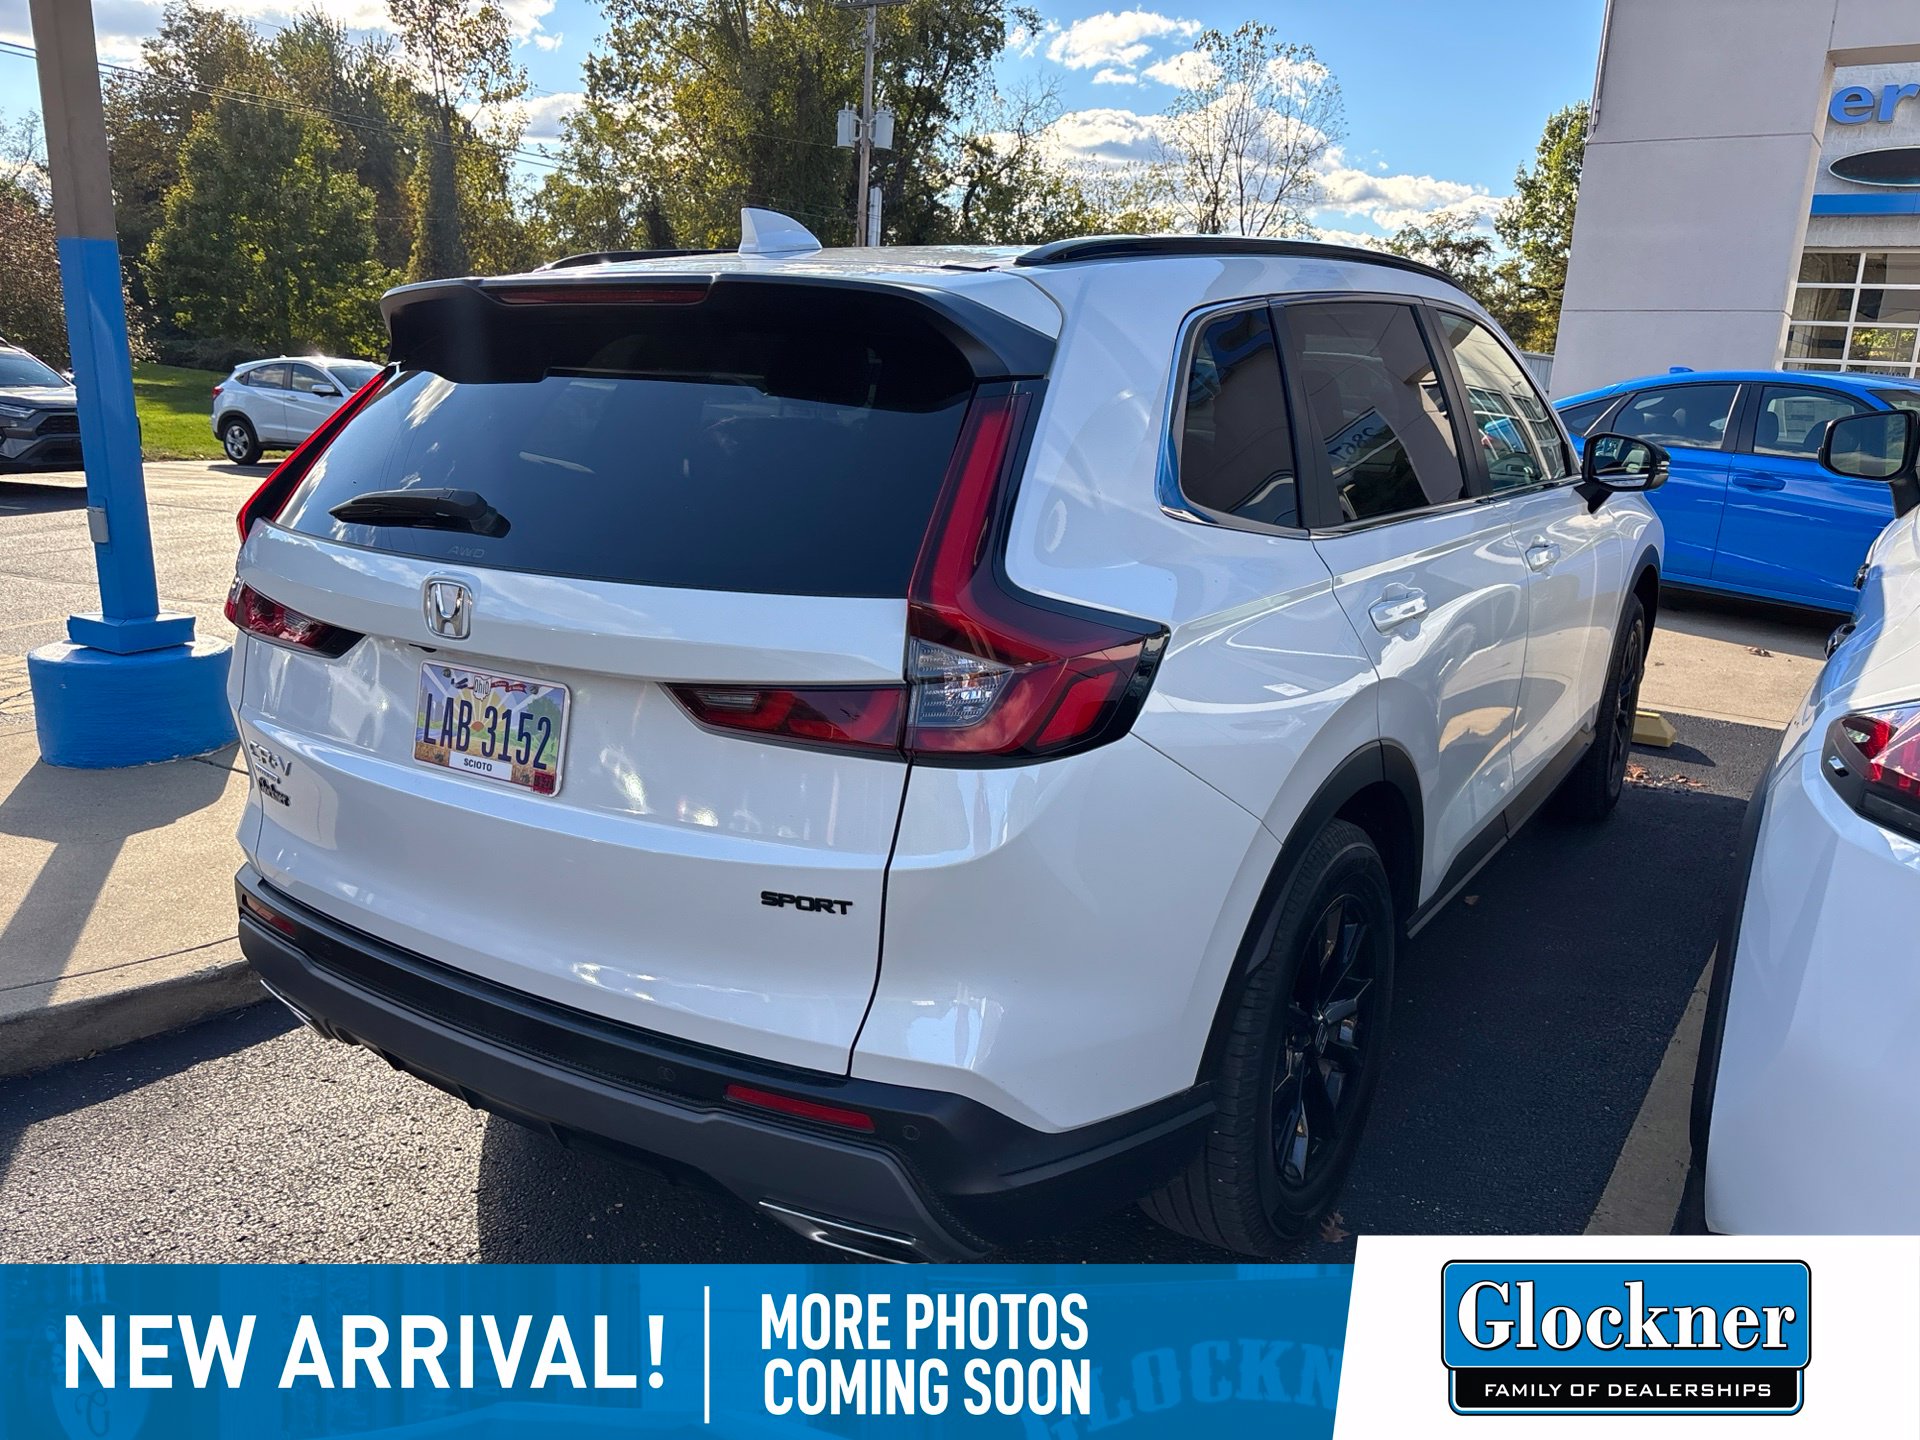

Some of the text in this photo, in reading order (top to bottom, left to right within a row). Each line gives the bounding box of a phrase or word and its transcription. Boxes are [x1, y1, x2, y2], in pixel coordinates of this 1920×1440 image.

[448, 545, 485, 558] AWD
[423, 693, 551, 770] LAB 3152
[463, 758, 492, 772] SCIOTO
[761, 891, 853, 915] SPORT
